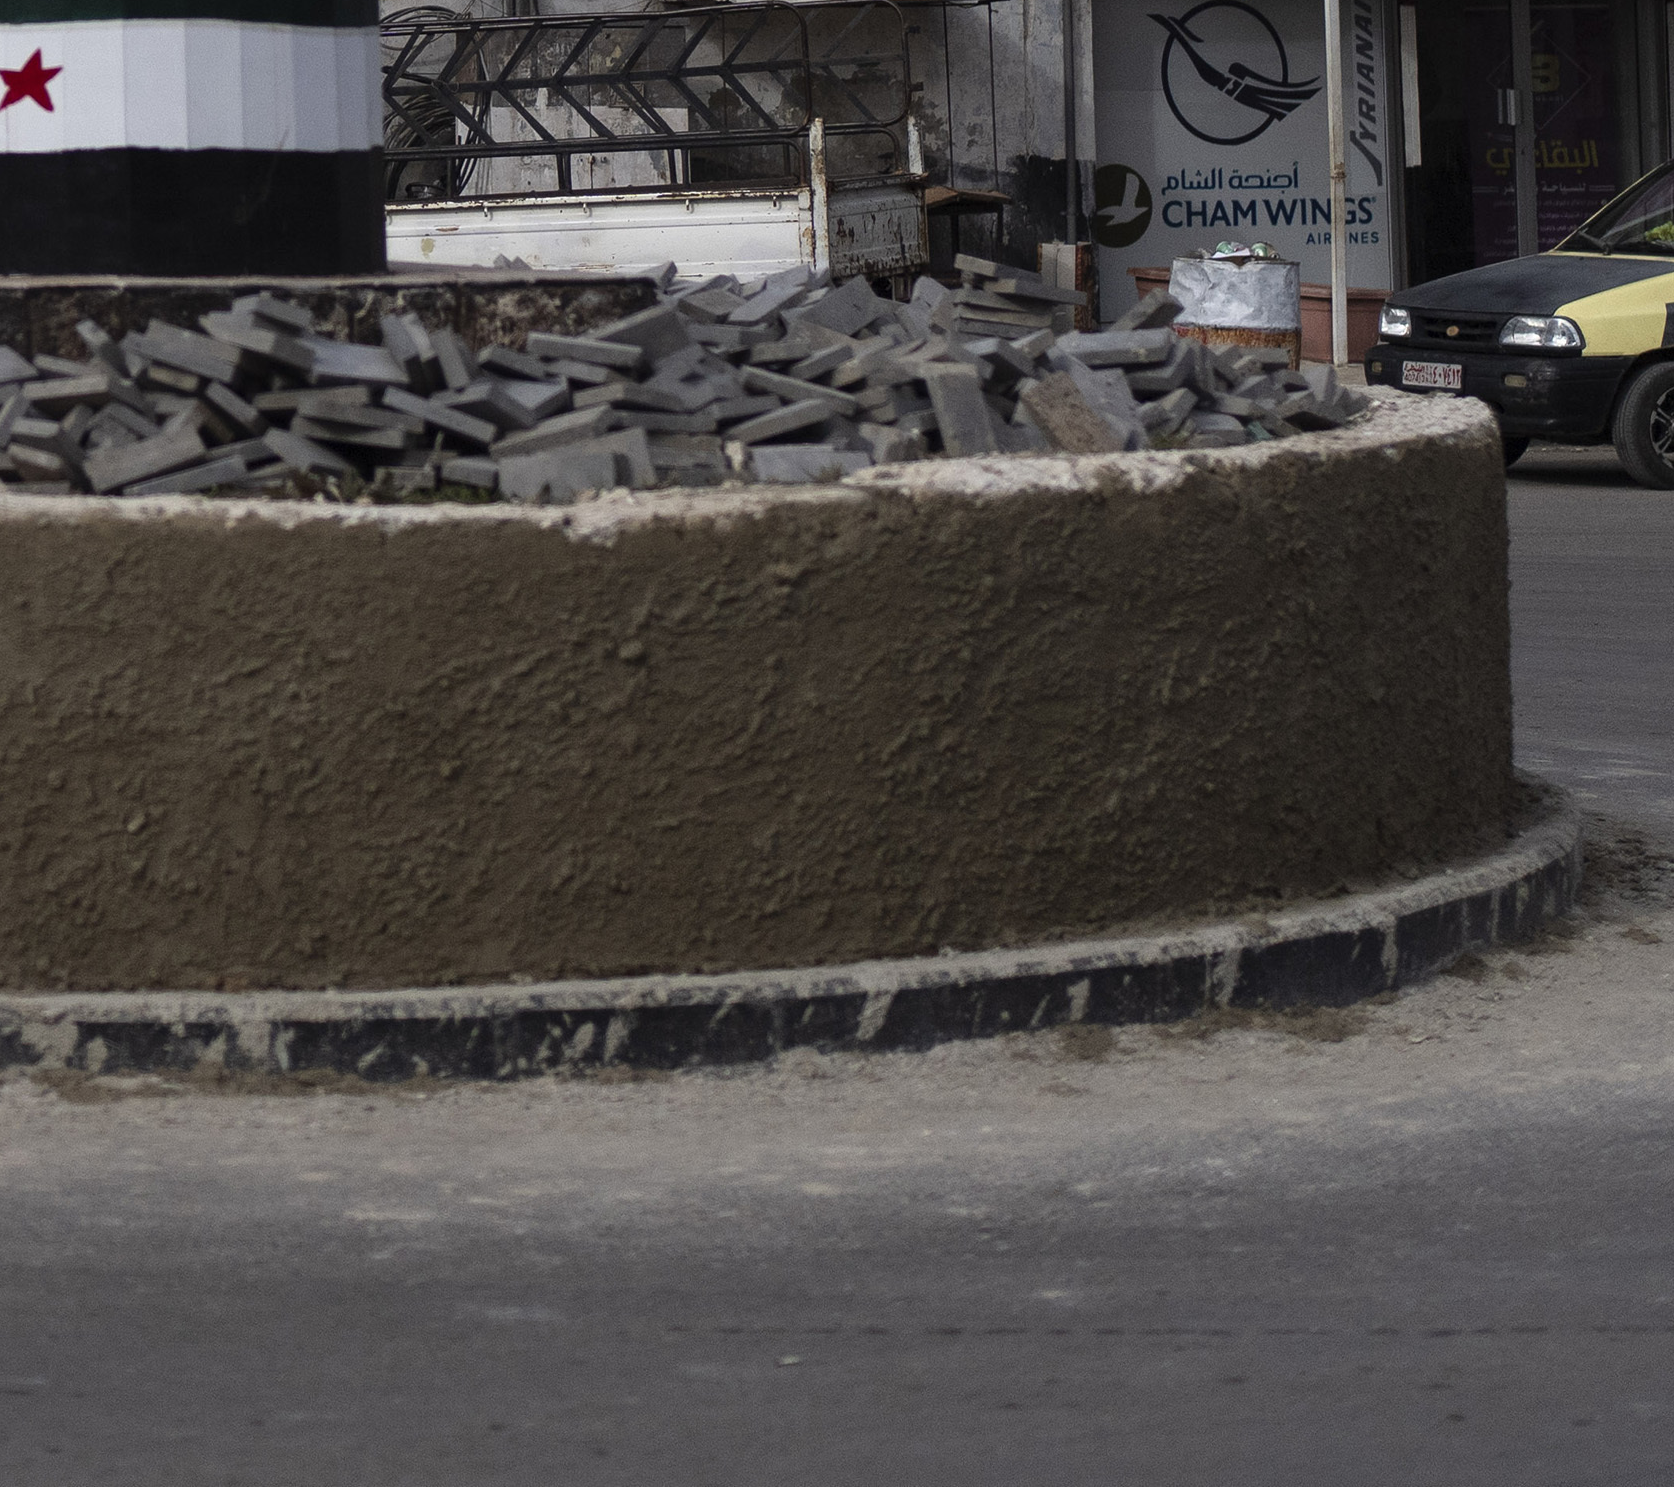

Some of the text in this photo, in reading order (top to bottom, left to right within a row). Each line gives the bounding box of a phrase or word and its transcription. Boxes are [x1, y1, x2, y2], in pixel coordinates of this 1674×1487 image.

[1161, 161, 1299, 196] أجنحة الشام
[1161, 199, 1257, 227] CHAM
[1306, 231, 1379, 246] AIRNES
